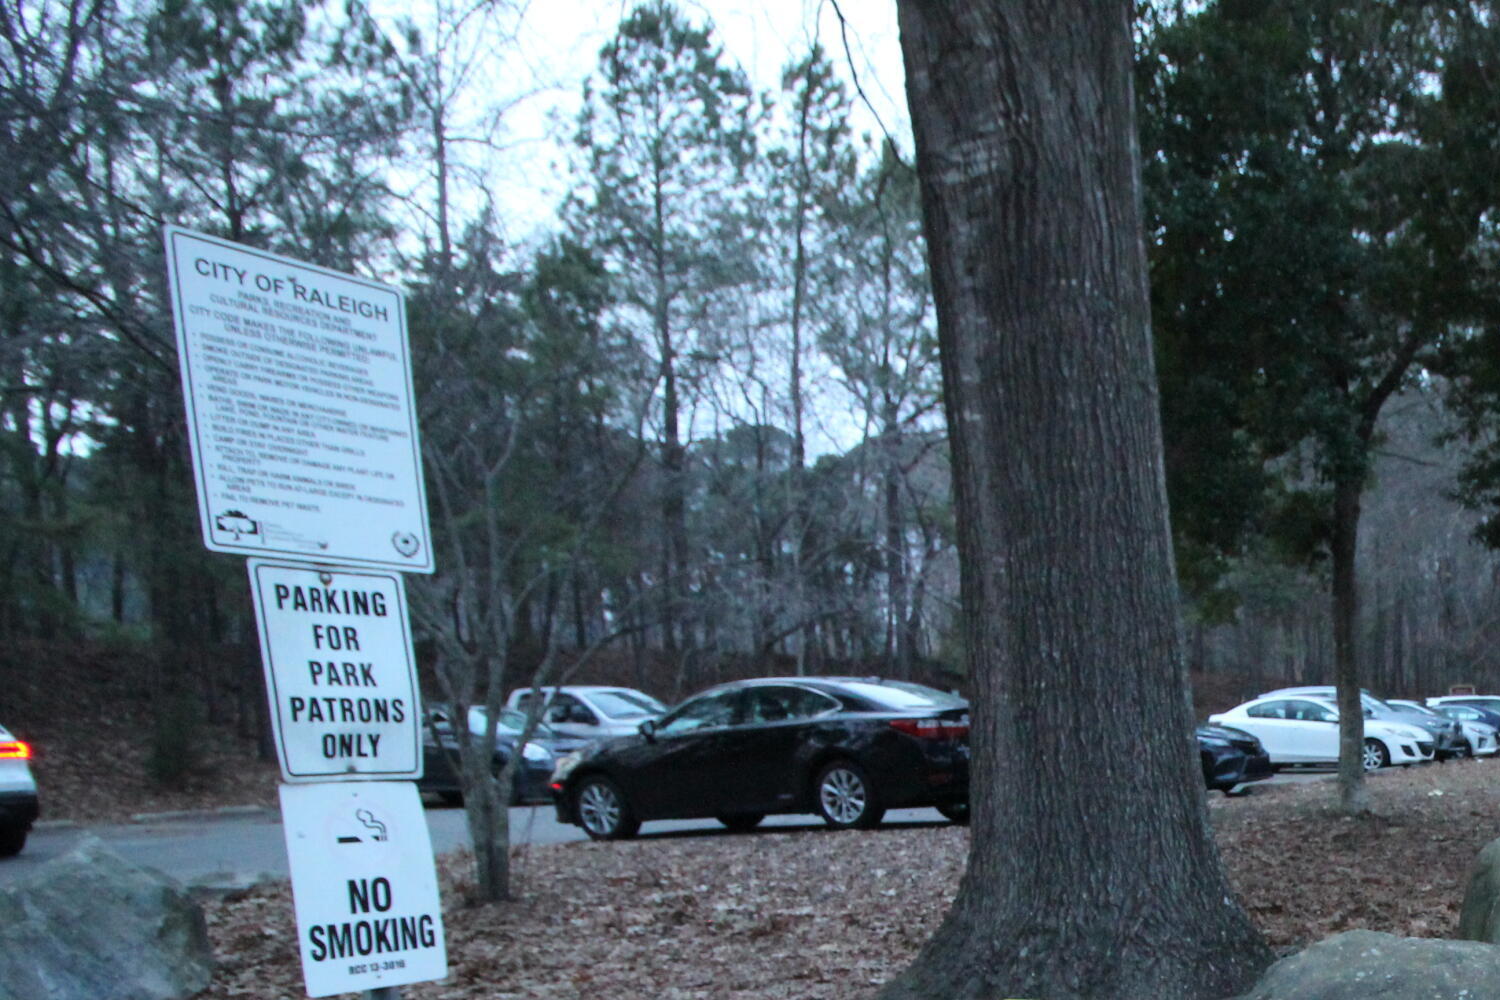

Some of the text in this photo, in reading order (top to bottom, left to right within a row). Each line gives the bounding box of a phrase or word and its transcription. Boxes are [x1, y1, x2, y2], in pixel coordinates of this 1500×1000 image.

[195, 258, 388, 321] CITY OF RALEIGH
[275, 582, 386, 616] PARKING
[313, 625, 359, 650] FOR
[309, 661, 376, 686] PARK
[290, 697, 404, 723] PATRONS
[323, 734, 380, 758] ONLY
[348, 877, 391, 914] NO
[310, 915, 435, 961] SMOKING
